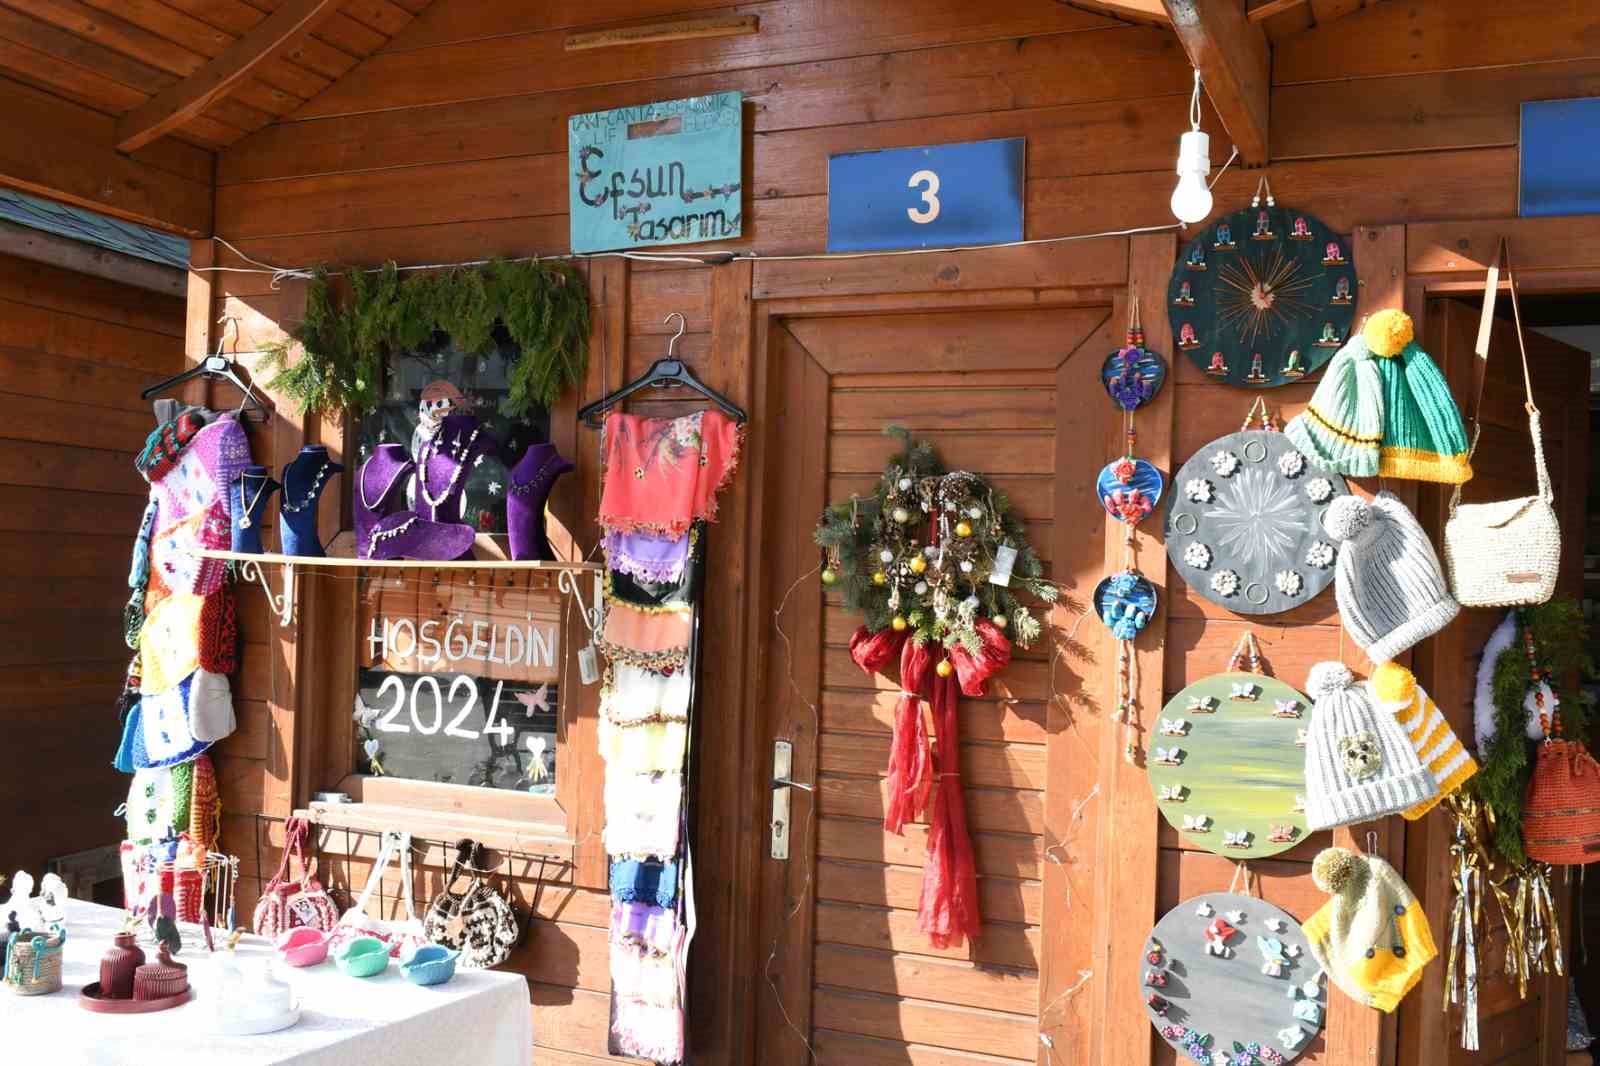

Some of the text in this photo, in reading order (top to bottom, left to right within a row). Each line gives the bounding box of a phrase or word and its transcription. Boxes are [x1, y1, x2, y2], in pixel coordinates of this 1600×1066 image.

[577, 145, 694, 221] Efsun
[906, 169, 941, 225] 3
[375, 674, 515, 748] 2024
